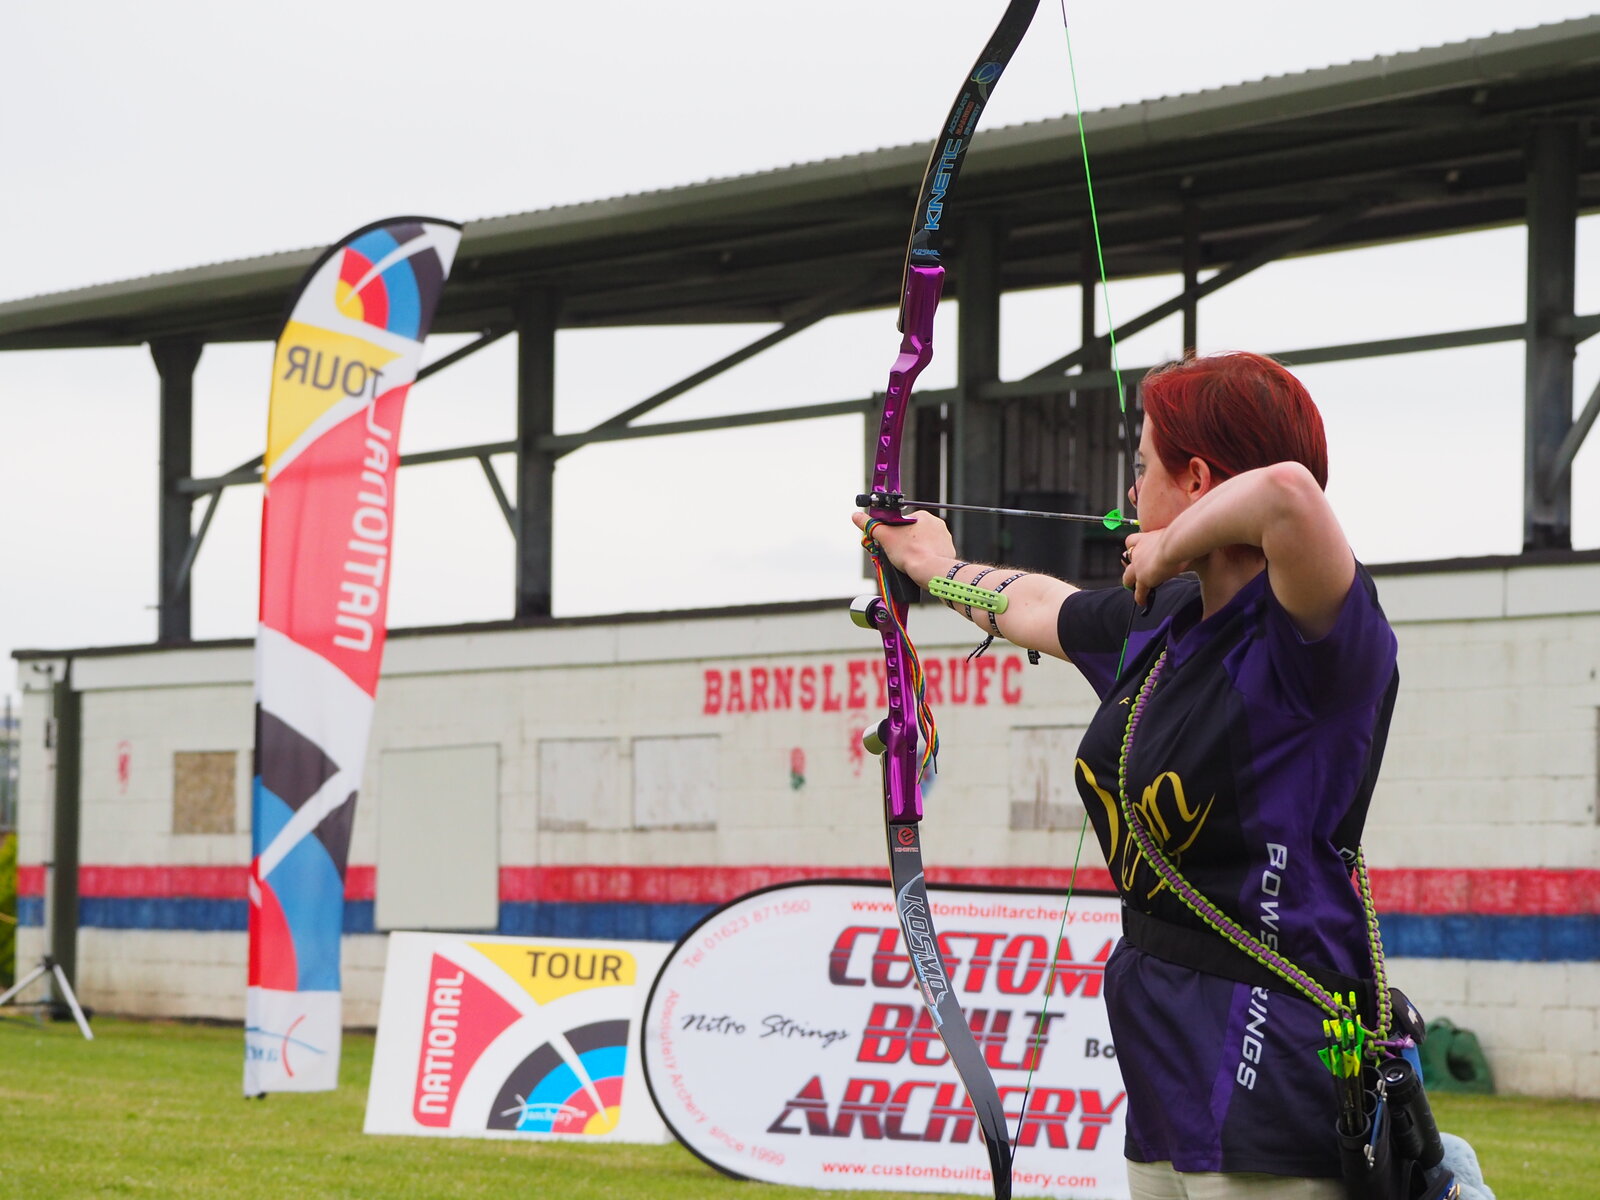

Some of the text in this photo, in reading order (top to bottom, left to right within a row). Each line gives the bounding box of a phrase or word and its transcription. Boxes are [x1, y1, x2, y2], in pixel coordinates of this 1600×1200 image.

[924, 138, 962, 230] KINETIC
[703, 655, 1024, 715] BARNSLEY RUFC
[527, 951, 623, 981] TOUR
[683, 899, 811, 968] Tel 01623 871560
[902, 894, 949, 992] KOSMO
[1237, 842, 1288, 1091] BOWSRINGS
[419, 970, 464, 1114] NATIONAL
[682, 1014, 850, 1048] Nitro Strings
[671, 1073, 708, 1123] Archery
[709, 1126, 745, 1153] since
[751, 1145, 785, 1166] 1999
[822, 1161, 1097, 1188] www.custombuiltahery.com
